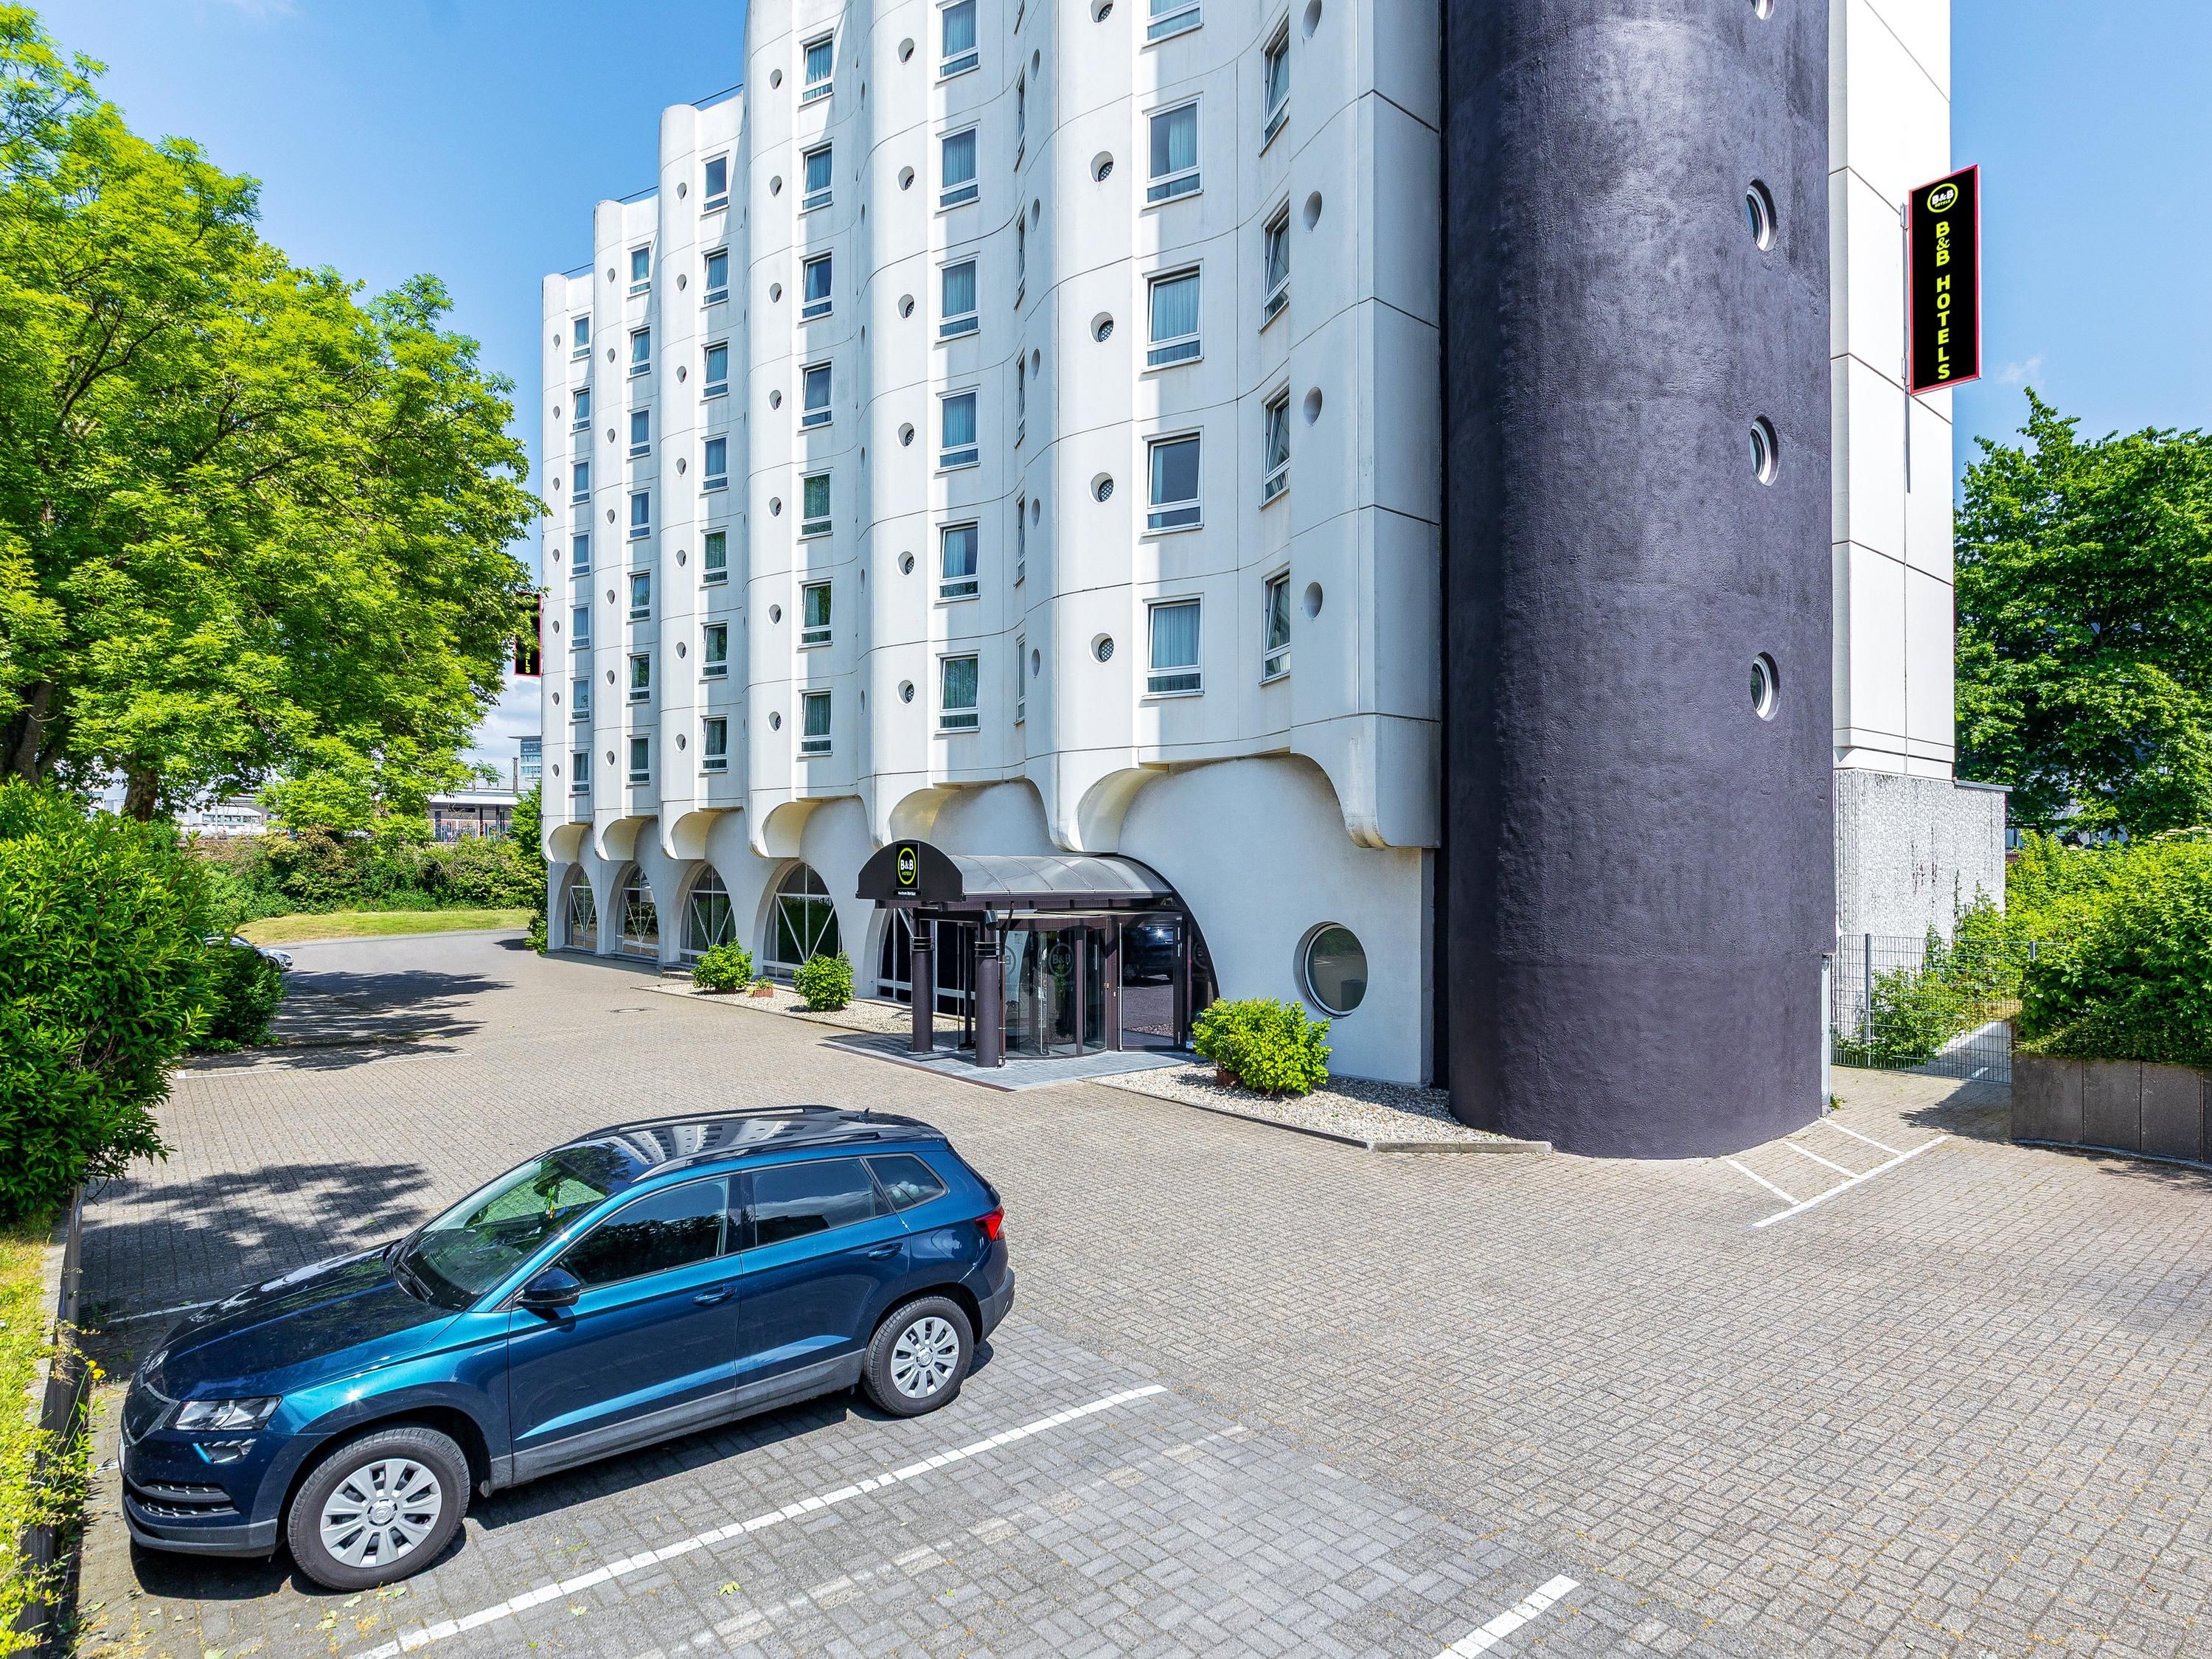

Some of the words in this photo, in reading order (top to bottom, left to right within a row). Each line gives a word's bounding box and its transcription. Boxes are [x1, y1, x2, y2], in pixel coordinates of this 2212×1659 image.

[1932, 189, 1954, 205] B&B
[1936, 221, 1950, 267] B&B
[1936, 274, 1950, 380] HOTELS
[900, 859, 914, 870] B&B
